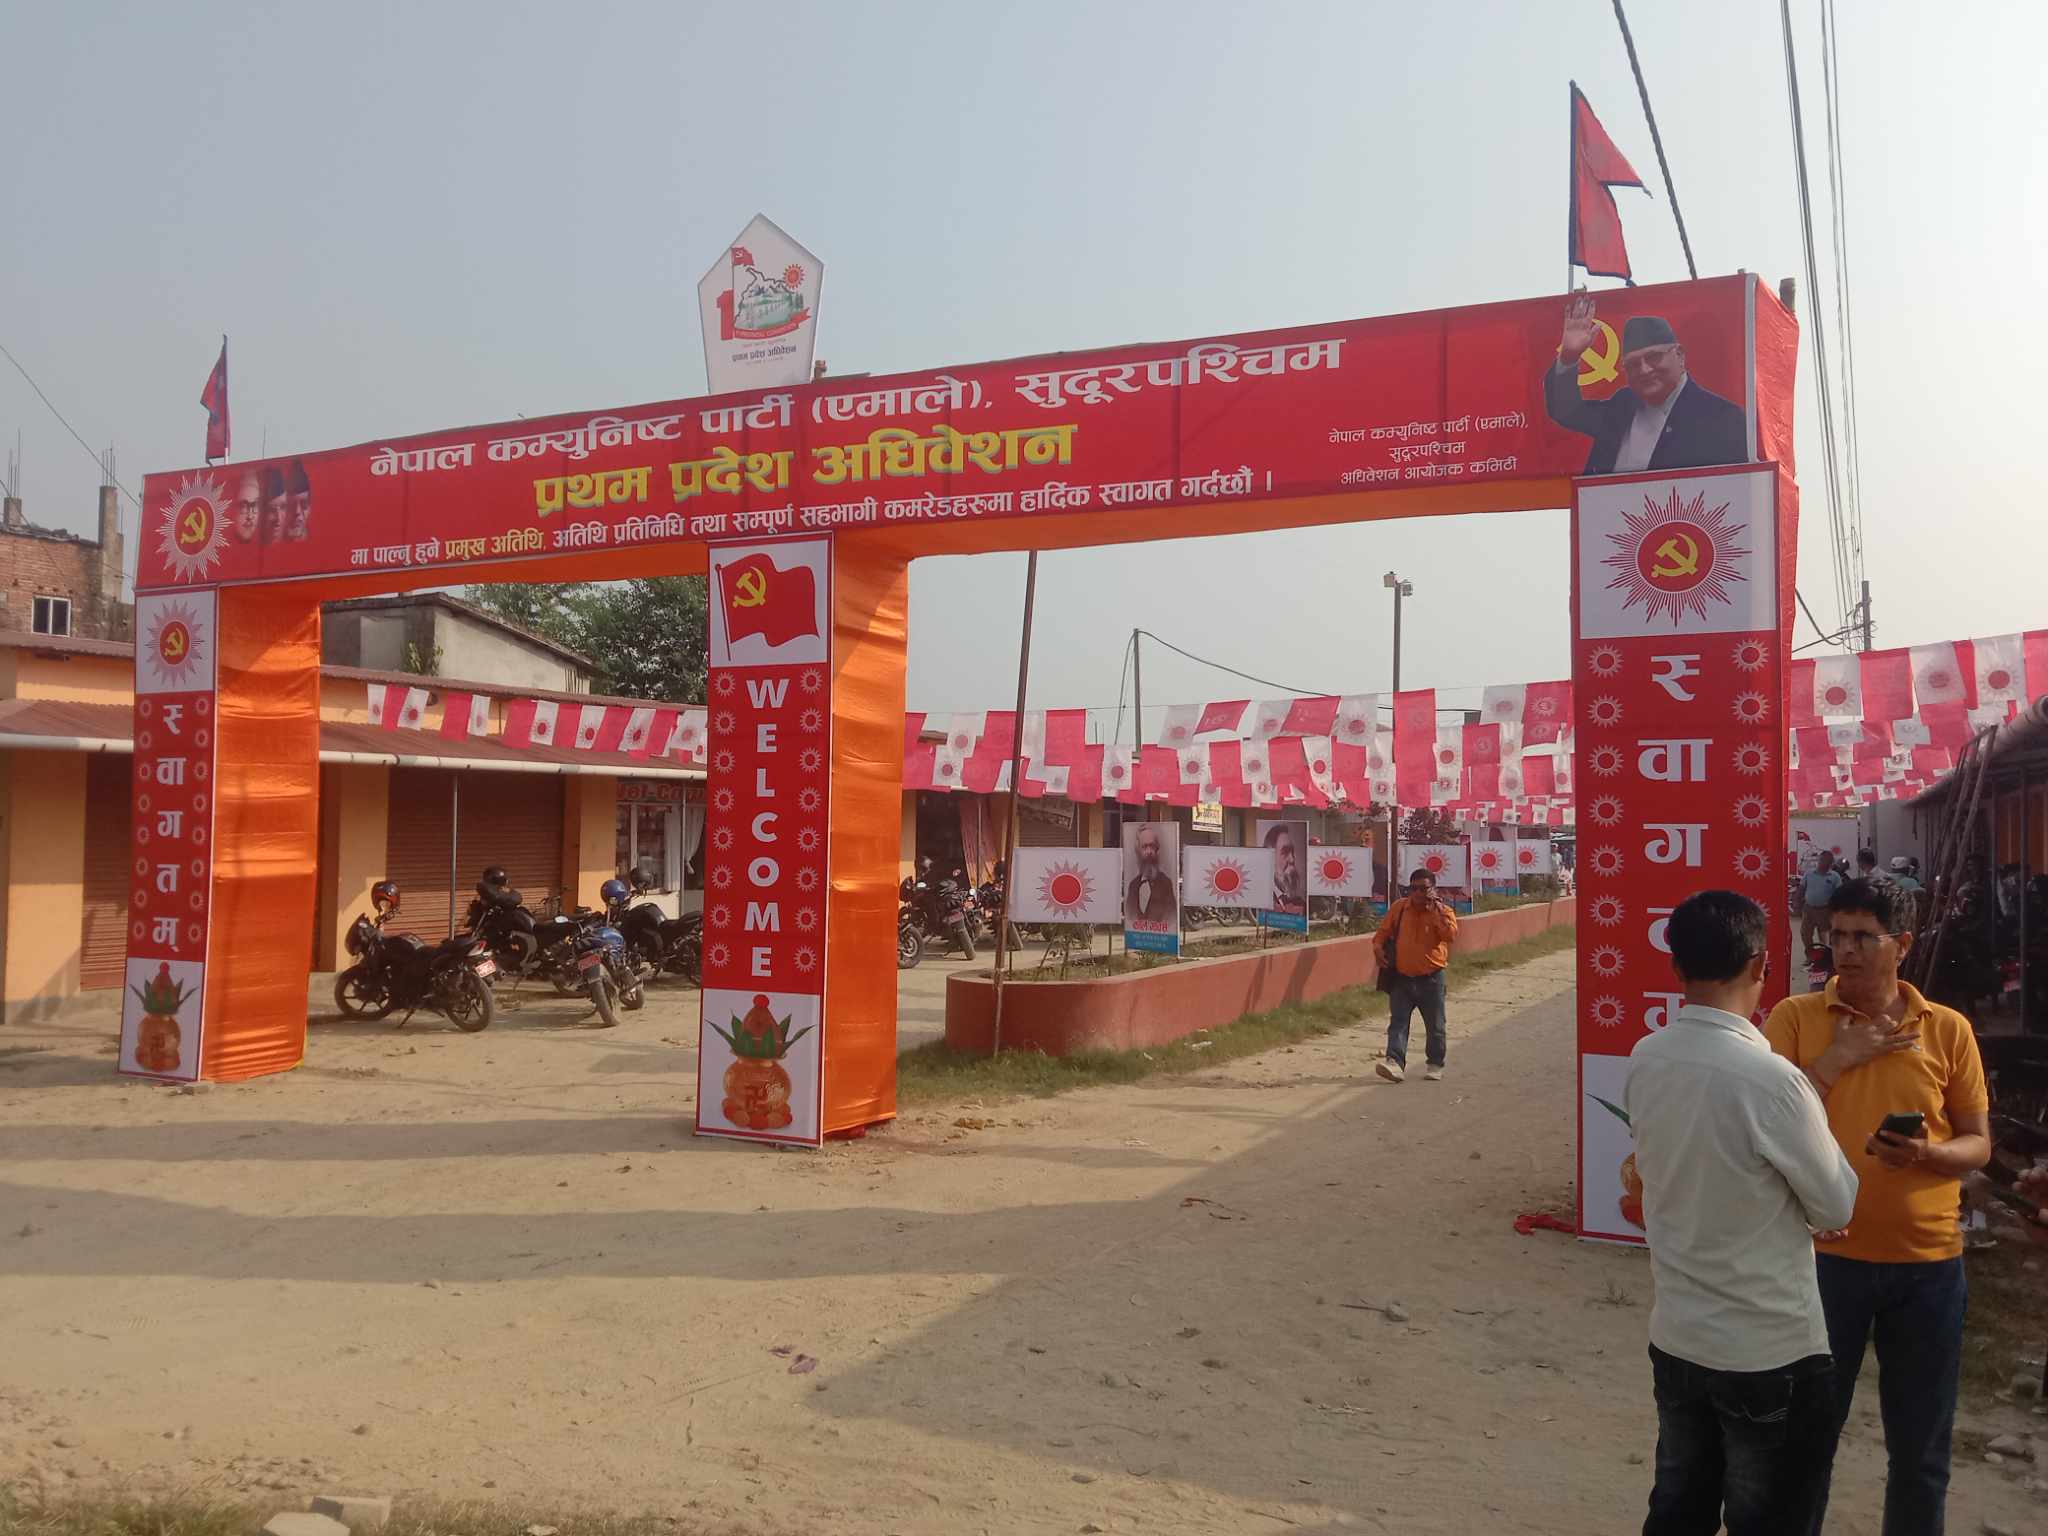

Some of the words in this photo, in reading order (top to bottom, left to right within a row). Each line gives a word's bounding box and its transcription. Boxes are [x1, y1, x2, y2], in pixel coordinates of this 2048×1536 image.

[370, 447, 476, 476] नेपाल
[487, 414, 685, 460] कम्युनिष्ट
[700, 394, 795, 433] पार्टी
[811, 375, 993, 424] (एमाले),
[1014, 338, 1347, 409] सुदूरपश्चिम
[1328, 428, 1365, 444] नेपाल
[1371, 422, 1438, 442] कम्युनिष्ट
[1443, 415, 1471, 433] पार्टी
[533, 466, 653, 518] प्रथम
[669, 446, 794, 503] प्रदेश
[811, 423, 1078, 486] अधिवेशन
[1340, 466, 1400, 486] अधिवेशन
[1404, 462, 1463, 480] आयोजक
[1470, 456, 1517, 473] कमिटी
[1388, 441, 1466, 463] सुदूरपश्चिम
[350, 549, 368, 566] मा
[373, 544, 411, 567] पाल्नु
[415, 537, 440, 565] हुने
[444, 537, 485, 560] प्रमुख
[553, 523, 608, 548] अतिथि
[614, 513, 685, 544] प्रतिनिधि
[691, 512, 727, 536] तथा
[732, 503, 793, 534] सम्पूर्ण
[799, 496, 878, 528] सहभागी
[1019, 481, 1092, 510] हार्दिक
[1099, 478, 1173, 506] स्वागत
[744, 678, 790, 977] WELCOME
